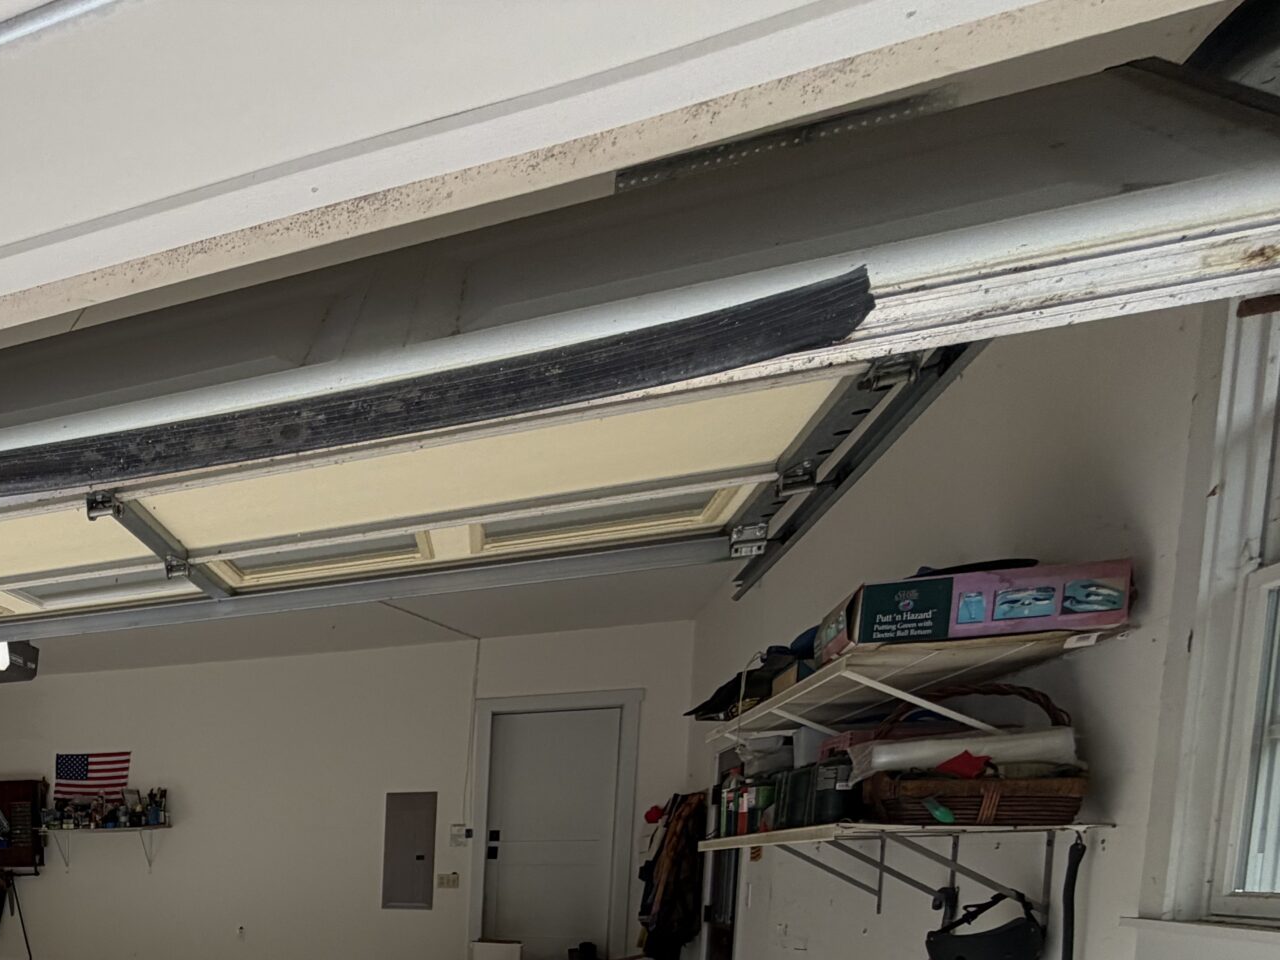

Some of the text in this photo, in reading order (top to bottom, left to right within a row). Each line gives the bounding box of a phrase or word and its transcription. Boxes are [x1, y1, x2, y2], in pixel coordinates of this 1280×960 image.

[876, 613, 892, 623] Putt
[903, 609, 932, 621] Hazard
[872, 631, 896, 639] Electric
